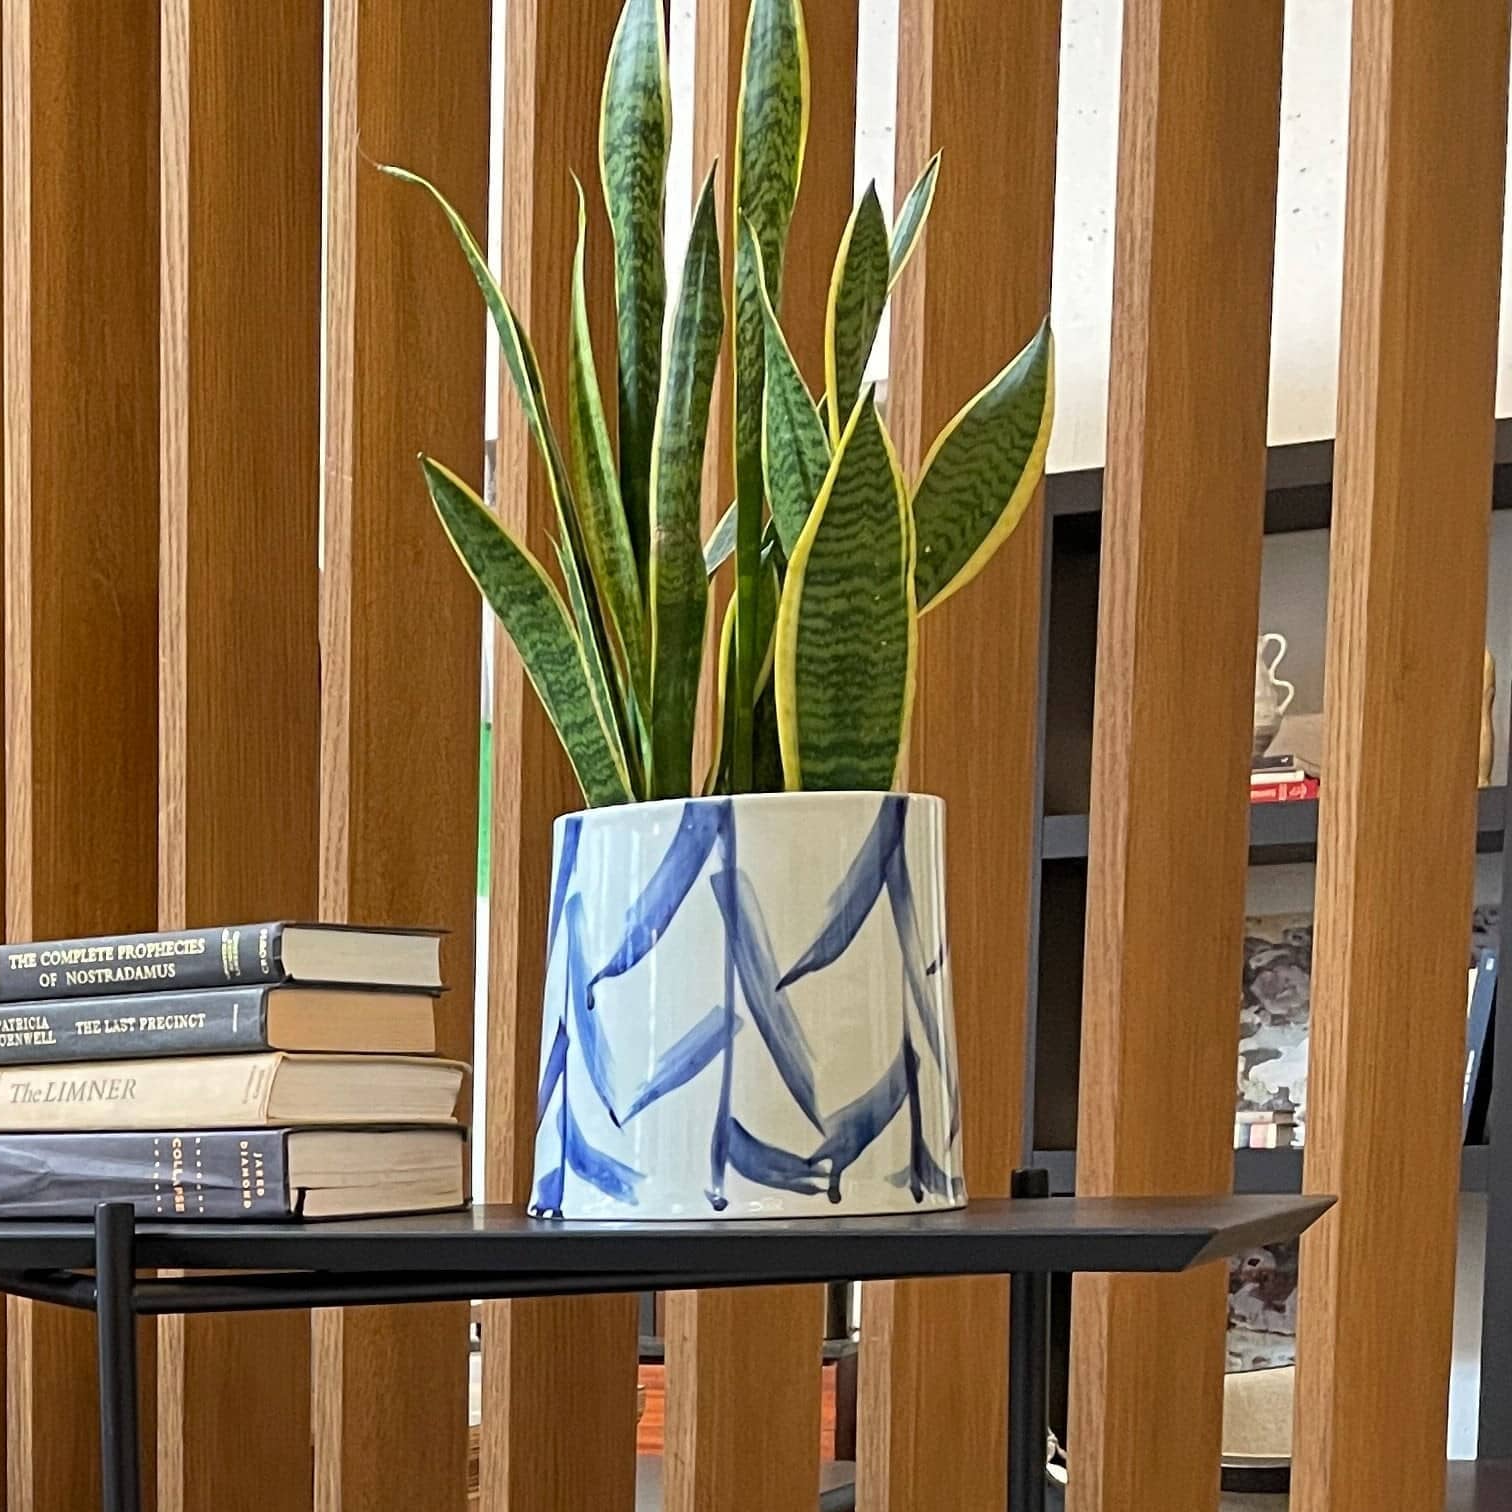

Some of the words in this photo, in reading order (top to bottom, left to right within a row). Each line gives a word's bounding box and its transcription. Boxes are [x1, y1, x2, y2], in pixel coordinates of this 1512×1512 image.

[8, 953, 37, 969] THE
[40, 946, 114, 966] COMPLETE
[117, 938, 206, 961] PROPHECIES
[39, 972, 58, 987] OF
[66, 963, 176, 986] NOSTRADAMUS
[75, 1019, 101, 1035] THE
[104, 1017, 136, 1033] LAST
[139, 1013, 206, 1031] PRECINCT
[10, 1082, 43, 1104] The
[44, 1078, 137, 1103] LIMNER
[239, 1141, 252, 1209] DIAMOND
[253, 1152, 265, 1197] JARED
